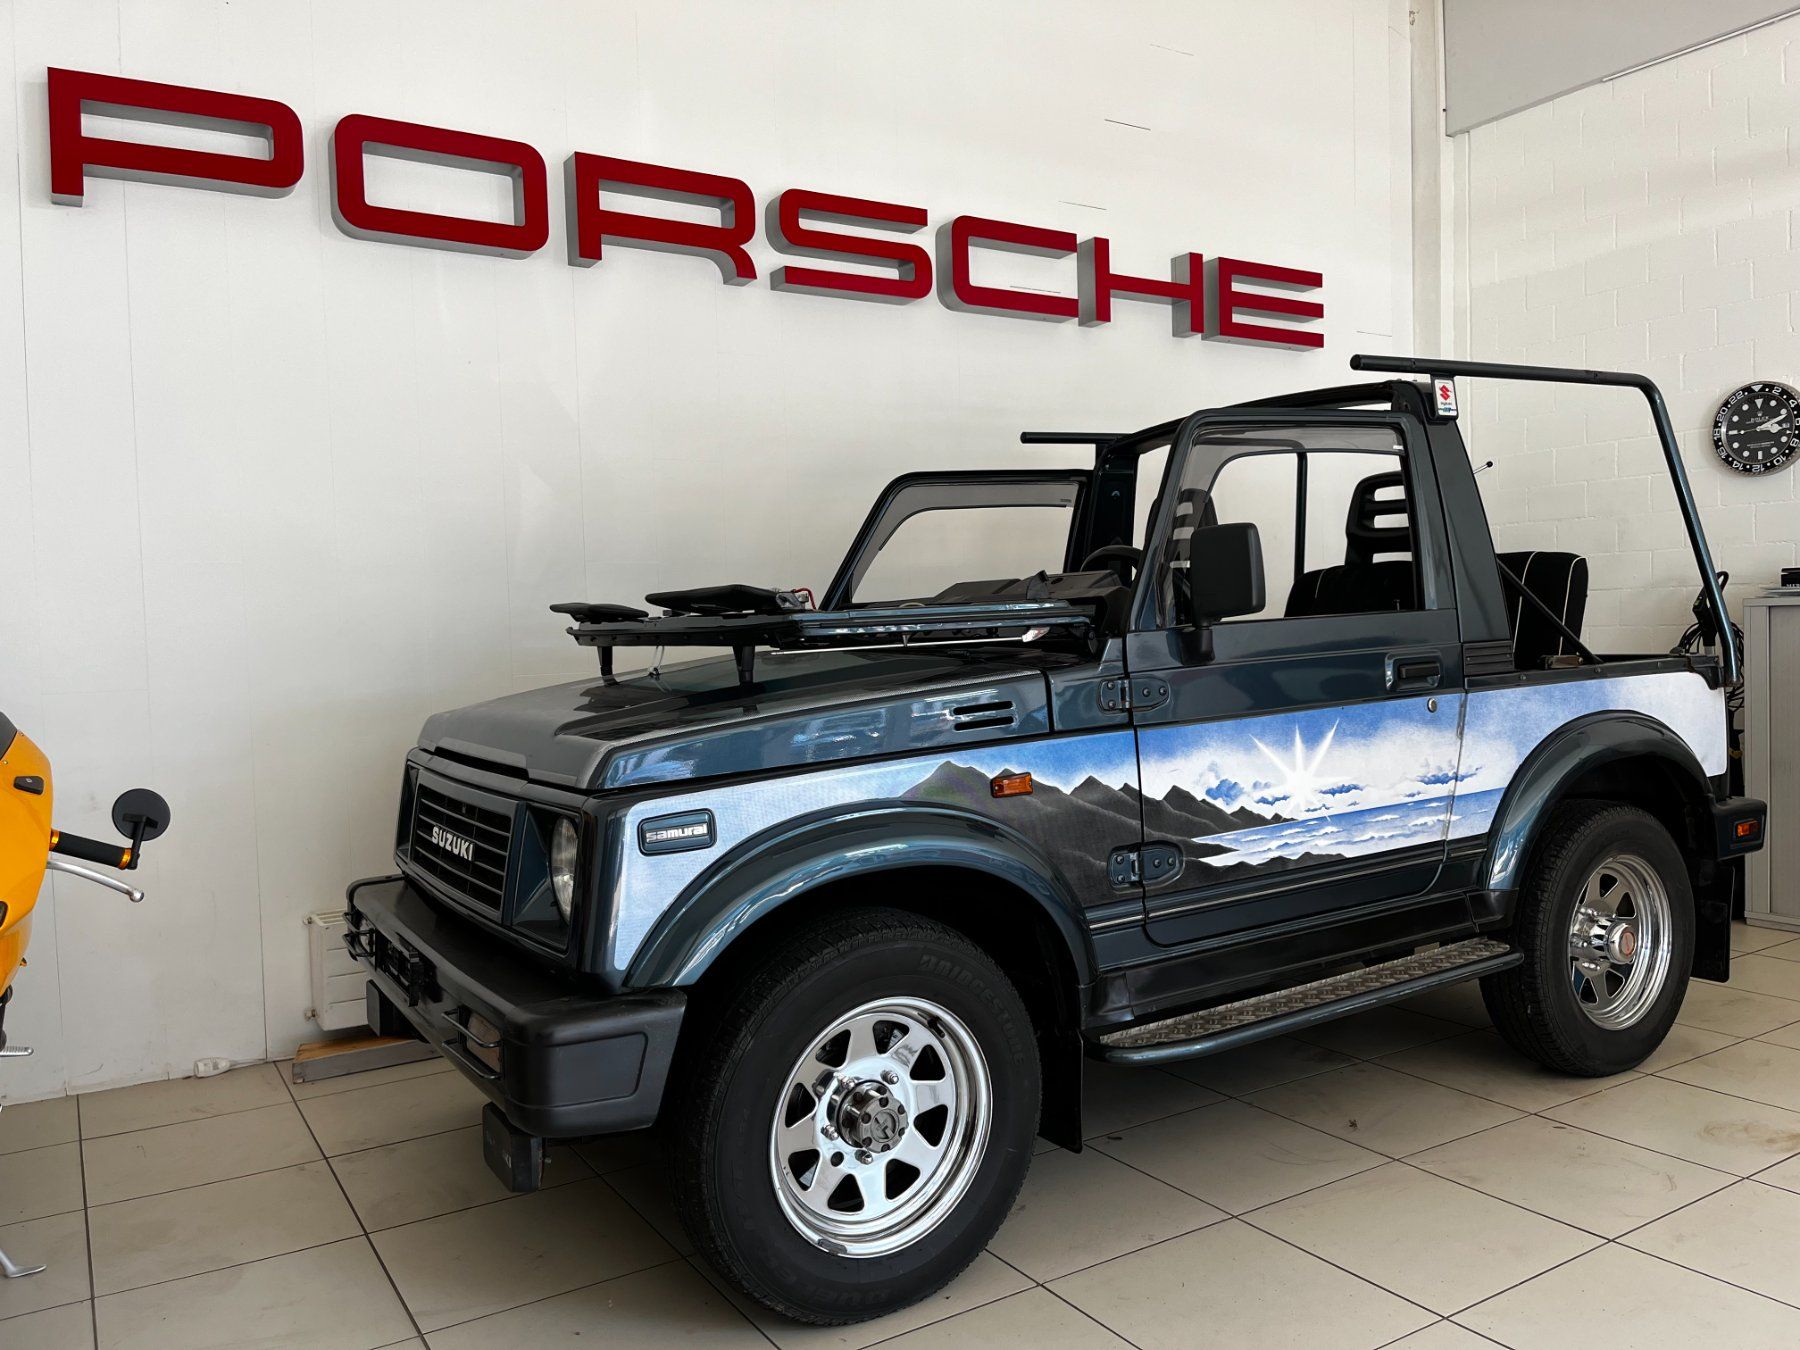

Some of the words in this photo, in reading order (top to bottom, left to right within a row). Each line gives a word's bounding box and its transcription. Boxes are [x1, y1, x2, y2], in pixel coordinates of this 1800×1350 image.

[47, 67, 1324, 349] PORSCHE
[1729, 391, 1744, 404] 22
[1717, 407, 1728, 421] 20
[431, 825, 474, 862] SUZUKI
